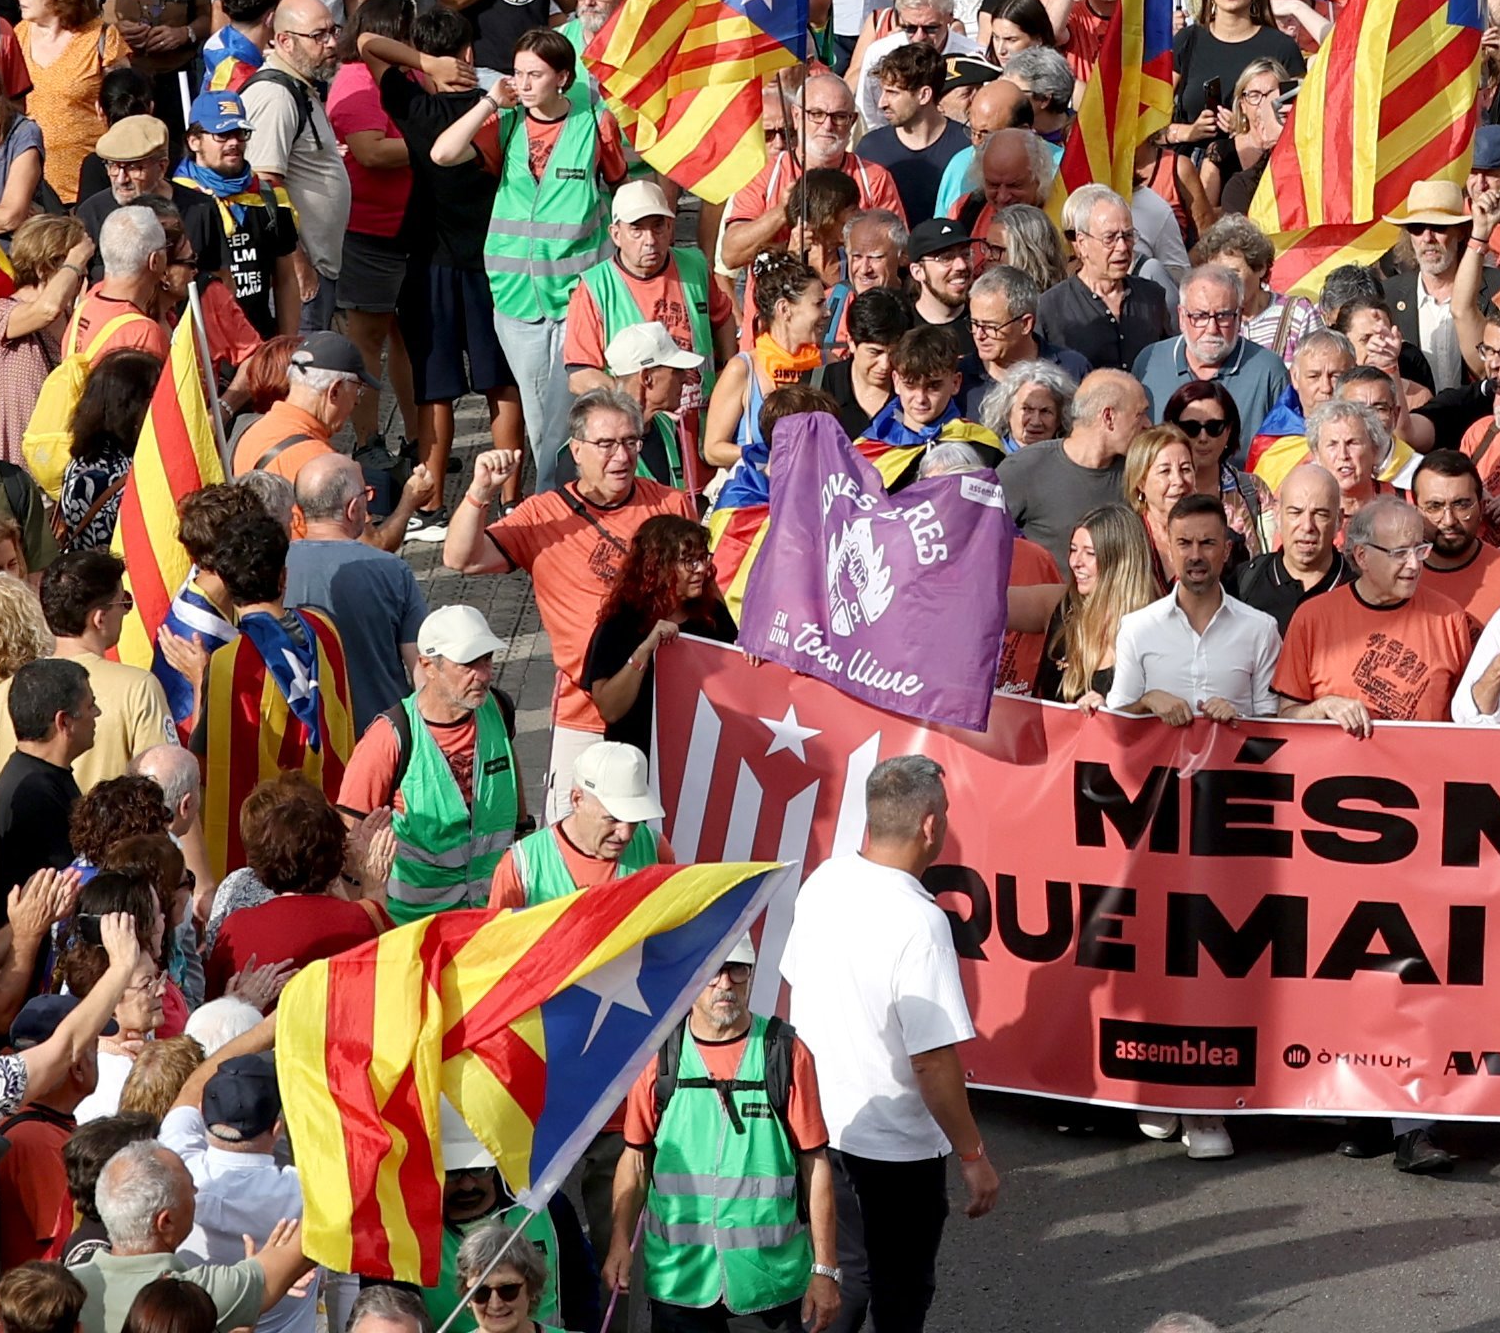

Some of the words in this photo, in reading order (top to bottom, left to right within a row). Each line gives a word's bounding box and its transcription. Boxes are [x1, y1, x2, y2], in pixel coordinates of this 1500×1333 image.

[773, 610, 788, 629] EN
[769, 628, 790, 648] UNA
[1073, 737, 1420, 865] MÉS
[922, 863, 1137, 973] QUE
[1164, 891, 1487, 987] MAI
[1114, 1039, 1239, 1068] assemblea
[1317, 1047, 1412, 1070] ÒMNIUM
